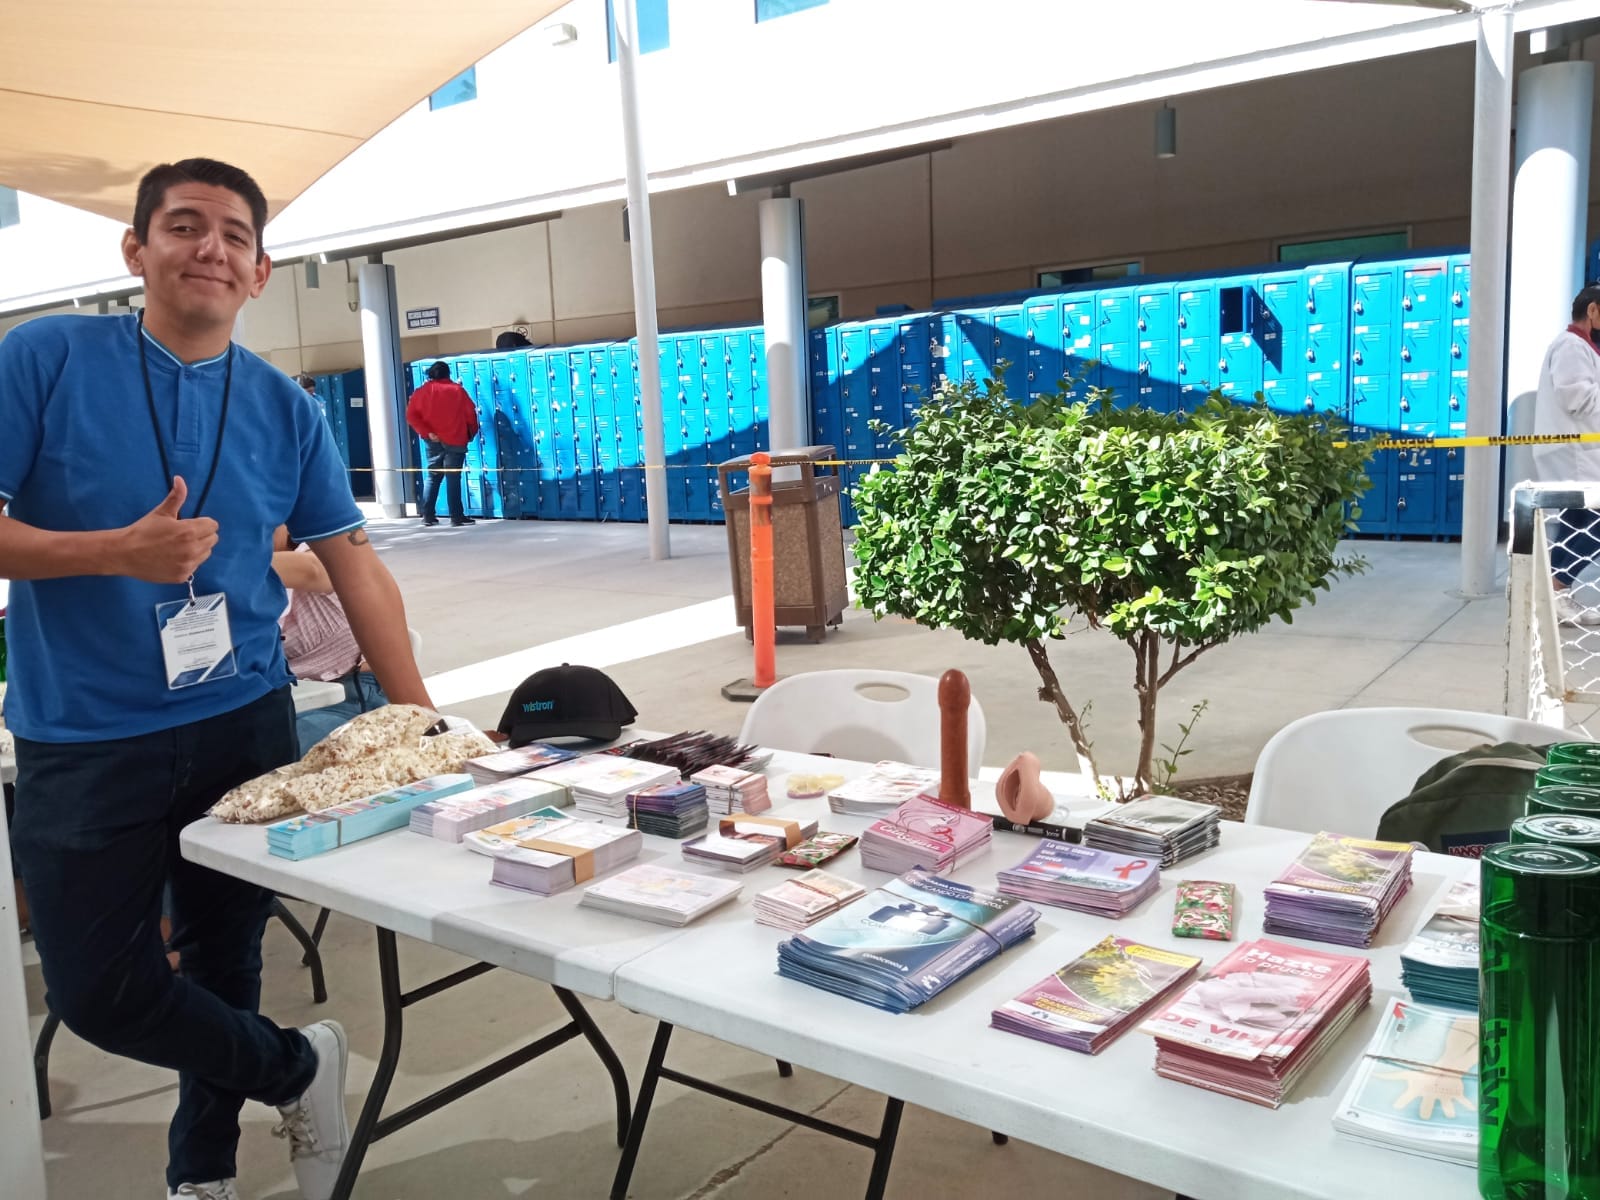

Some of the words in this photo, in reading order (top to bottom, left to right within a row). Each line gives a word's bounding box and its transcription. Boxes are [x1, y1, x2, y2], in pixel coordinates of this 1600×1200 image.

[522, 700, 554, 713] wistron
[1246, 948, 1332, 973] Hazte
[1257, 961, 1326, 979] prueba
[1160, 1012, 1200, 1028] DE
